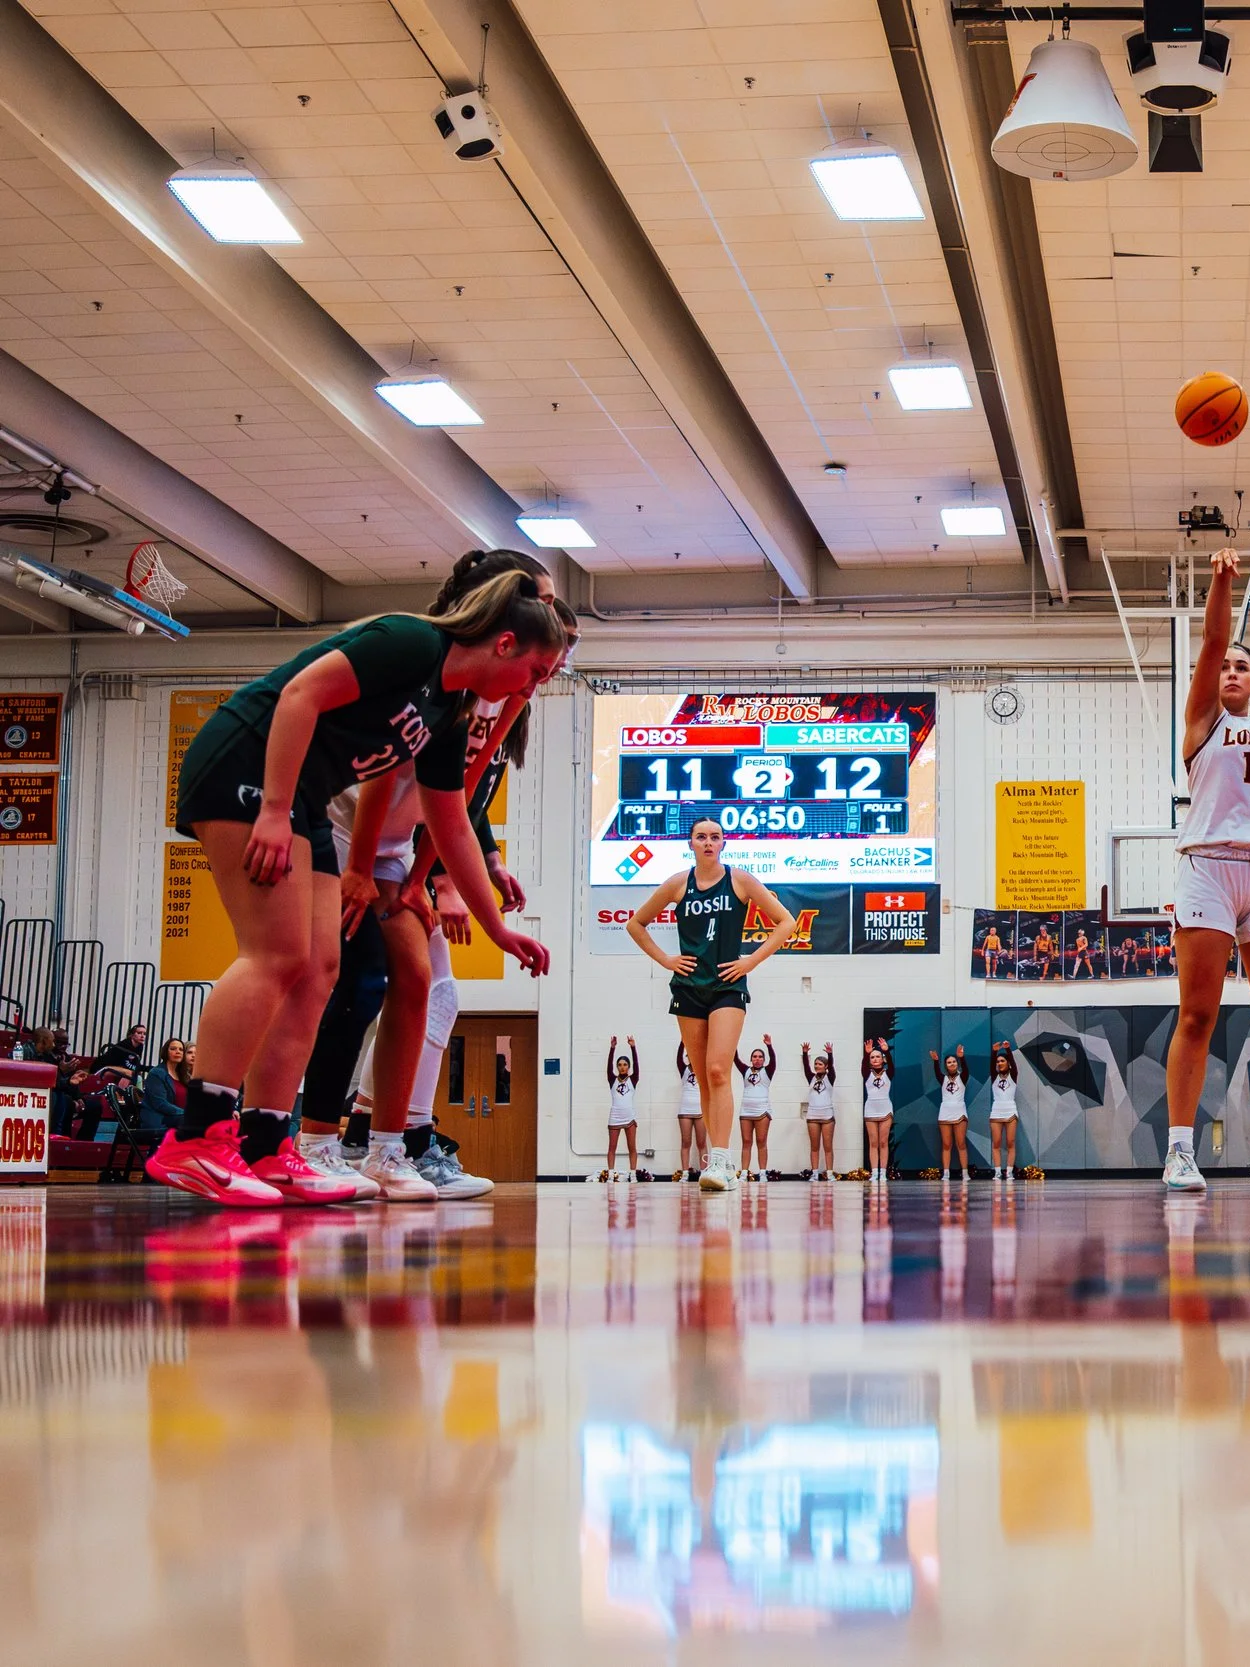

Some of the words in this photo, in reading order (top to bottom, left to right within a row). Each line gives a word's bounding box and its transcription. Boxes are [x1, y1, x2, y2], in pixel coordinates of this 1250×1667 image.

[735, 697, 769, 705] ROCKY
[771, 697, 821, 705] MOUNTAIN
[742, 704, 821, 723] LOBOS
[622, 729, 687, 745] LOBOS
[797, 727, 905, 744] SABERCATS
[745, 759, 783, 767] PERIOD
[645, 758, 712, 800] 11
[755, 770, 772, 794] 2
[814, 757, 881, 799] 12
[1002, 786, 1035, 796] Alma
[1041, 786, 1079, 796] Mater
[624, 805, 663, 814] FOULS
[863, 803, 902, 812] FOULS
[720, 806, 806, 831] 06:50
[875, 814, 890, 834] 1
[635, 816, 650, 835] 1
[864, 847, 911, 857] BACHUS
[170, 859, 189, 870] BOYS
[757, 863, 776, 873] LOT!
[810, 858, 839, 867] Collins
[849, 857, 911, 867] SCHANKER
[168, 877, 191, 885] 1984
[168, 890, 191, 898] 1985
[167, 903, 190, 911] 1987
[685, 894, 732, 917] FOSSIL
[166, 915, 189, 924] 2001
[864, 911, 925, 928] PROTECT
[166, 928, 188, 937] 2021
[706, 918, 716, 941] 4
[864, 927, 888, 941] THIS
[890, 927, 928, 941] HOUSE.
[18, 1092, 28, 1107] OF
[31, 1093, 46, 1108] THE
[0, 1118, 45, 1162] OBOS
